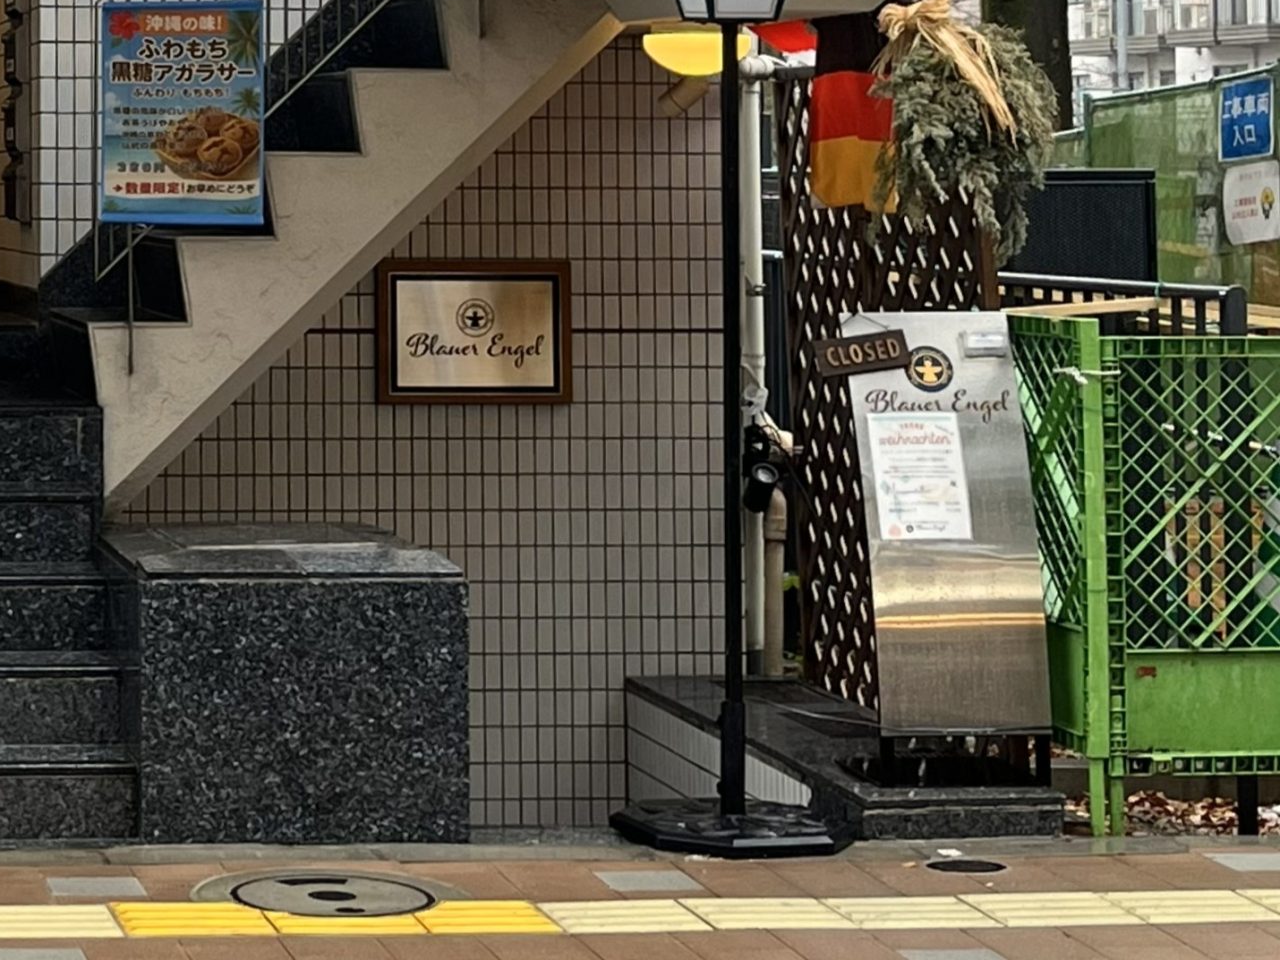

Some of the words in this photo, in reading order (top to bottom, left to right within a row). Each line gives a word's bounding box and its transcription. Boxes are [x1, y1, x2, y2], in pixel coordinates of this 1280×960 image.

[139, 38, 228, 60] ふわもち
[111, 61, 255, 83] 黒糖アガラサー
[1223, 93, 1269, 120] 工事車両
[1232, 125, 1257, 148] 入口
[406, 332, 479, 358] Blauer
[487, 333, 545, 369] Engel
[826, 338, 900, 367] CLOSED
[865, 388, 942, 414] Blauer
[951, 388, 1010, 424] Engel
